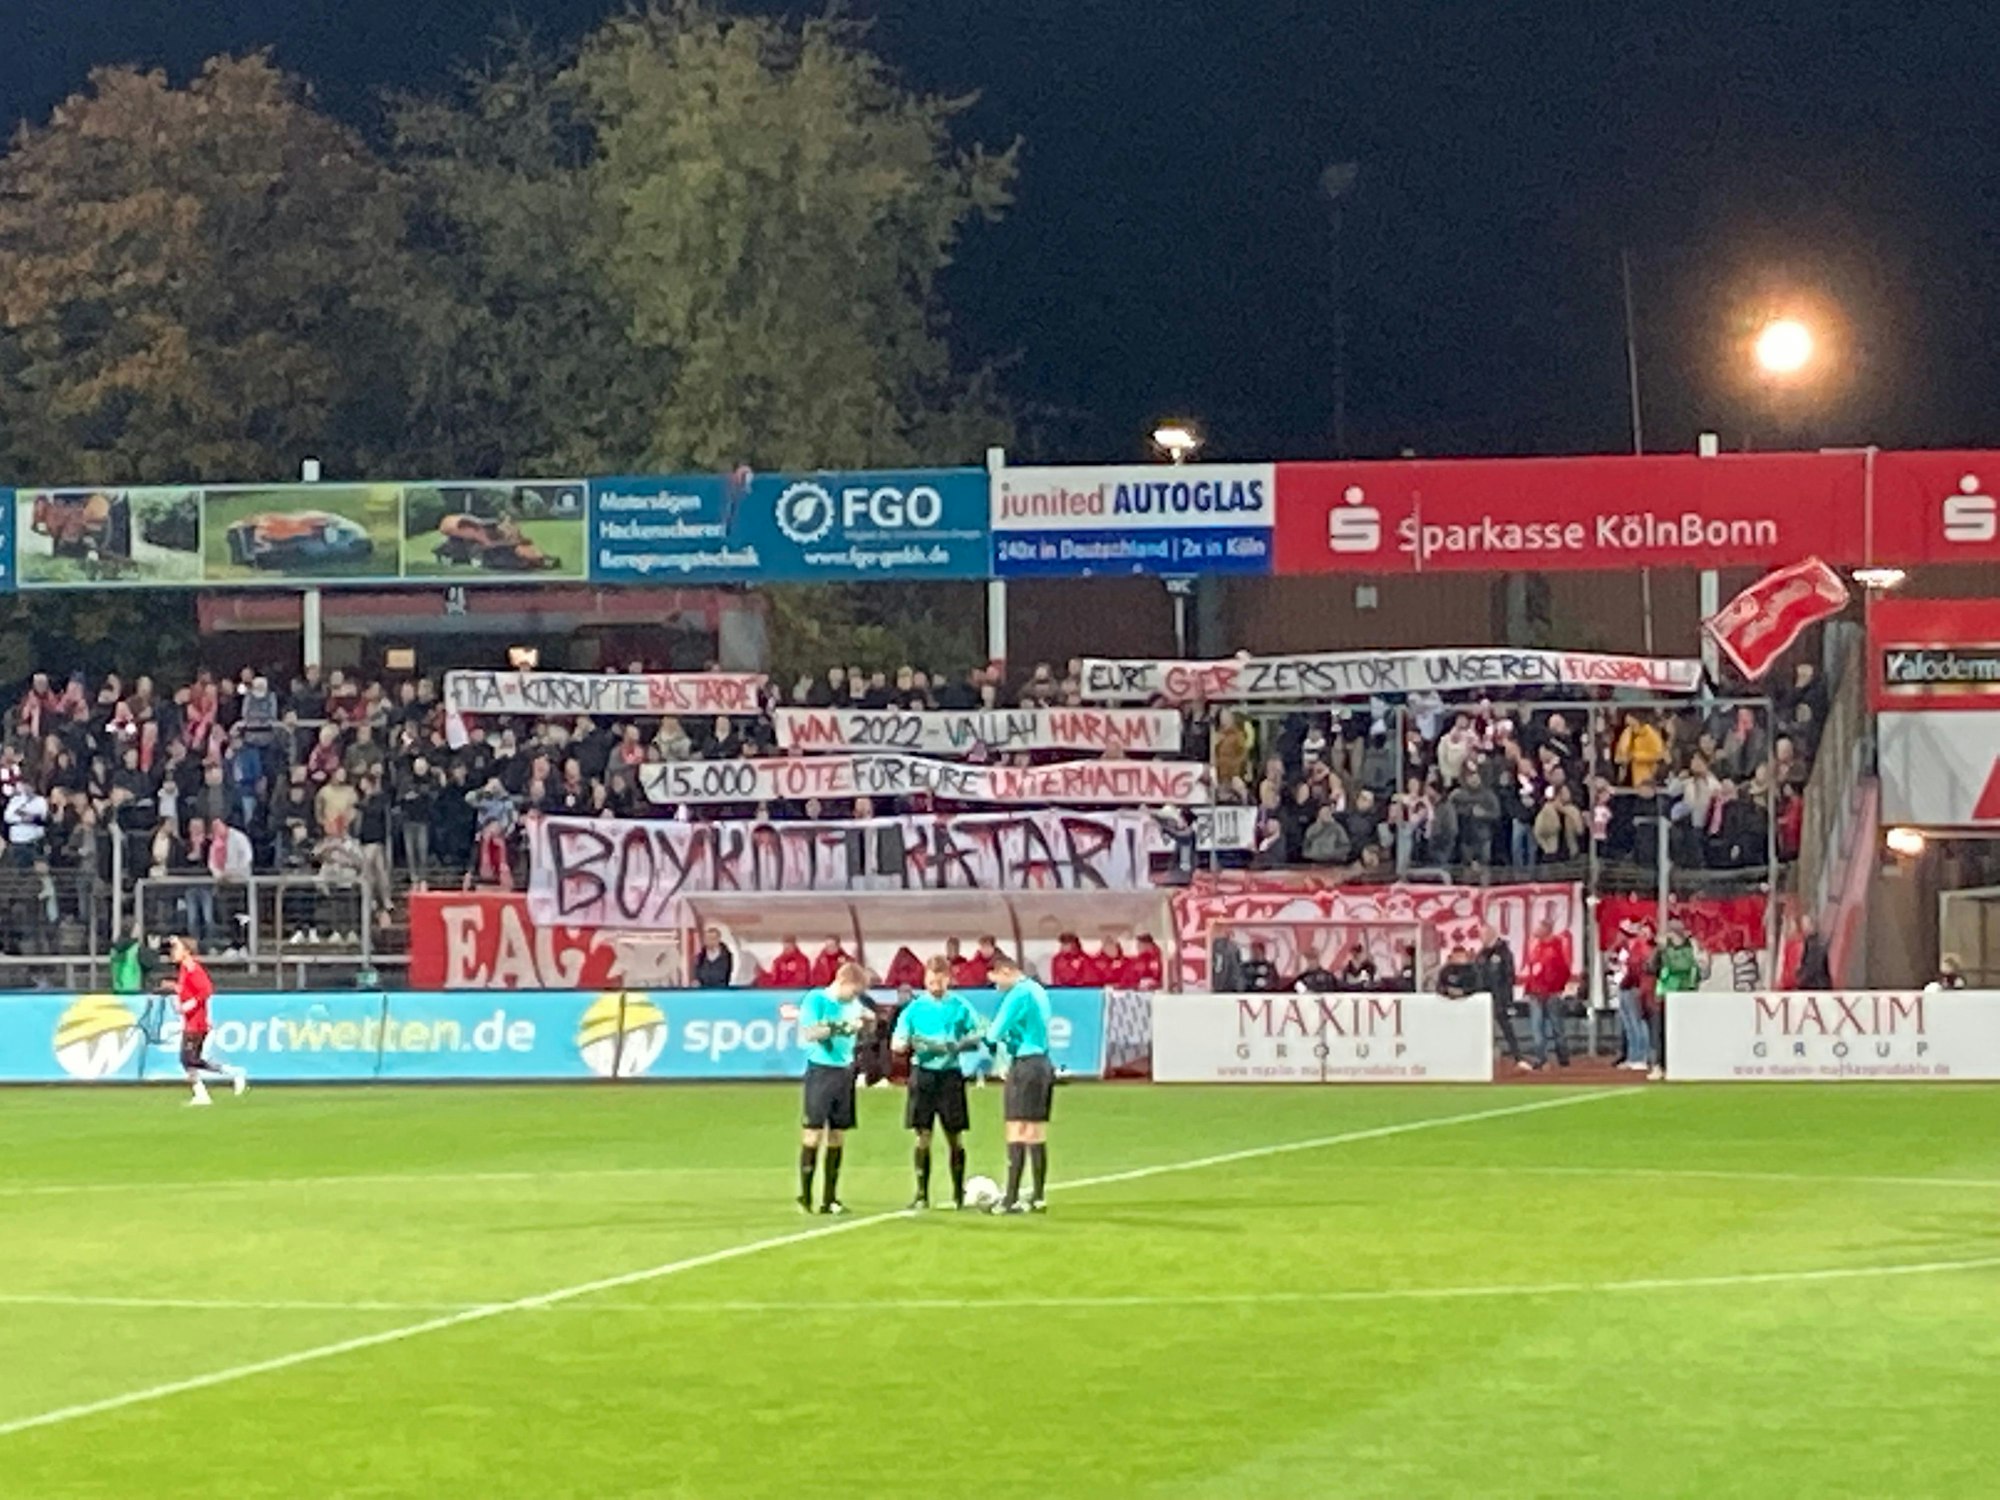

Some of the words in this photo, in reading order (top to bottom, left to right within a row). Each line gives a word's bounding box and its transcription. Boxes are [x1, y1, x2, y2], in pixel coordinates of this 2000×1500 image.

[842, 486, 943, 527] FGO
[1000, 482, 1104, 518] junited
[1113, 480, 1264, 514] AUTOGLAS
[1398, 515, 1583, 559] Sparkasse
[1596, 512, 1779, 548] KölnBonn
[1424, 653, 1560, 684] UNSEREN
[849, 714, 923, 749] 2022
[648, 762, 757, 797] 15.000
[758, 761, 849, 795] TOTE
[159, 1010, 536, 1062] sortwetten.de
[1236, 998, 1405, 1038] MAXIM
[1753, 996, 1927, 1036] MAXIM
